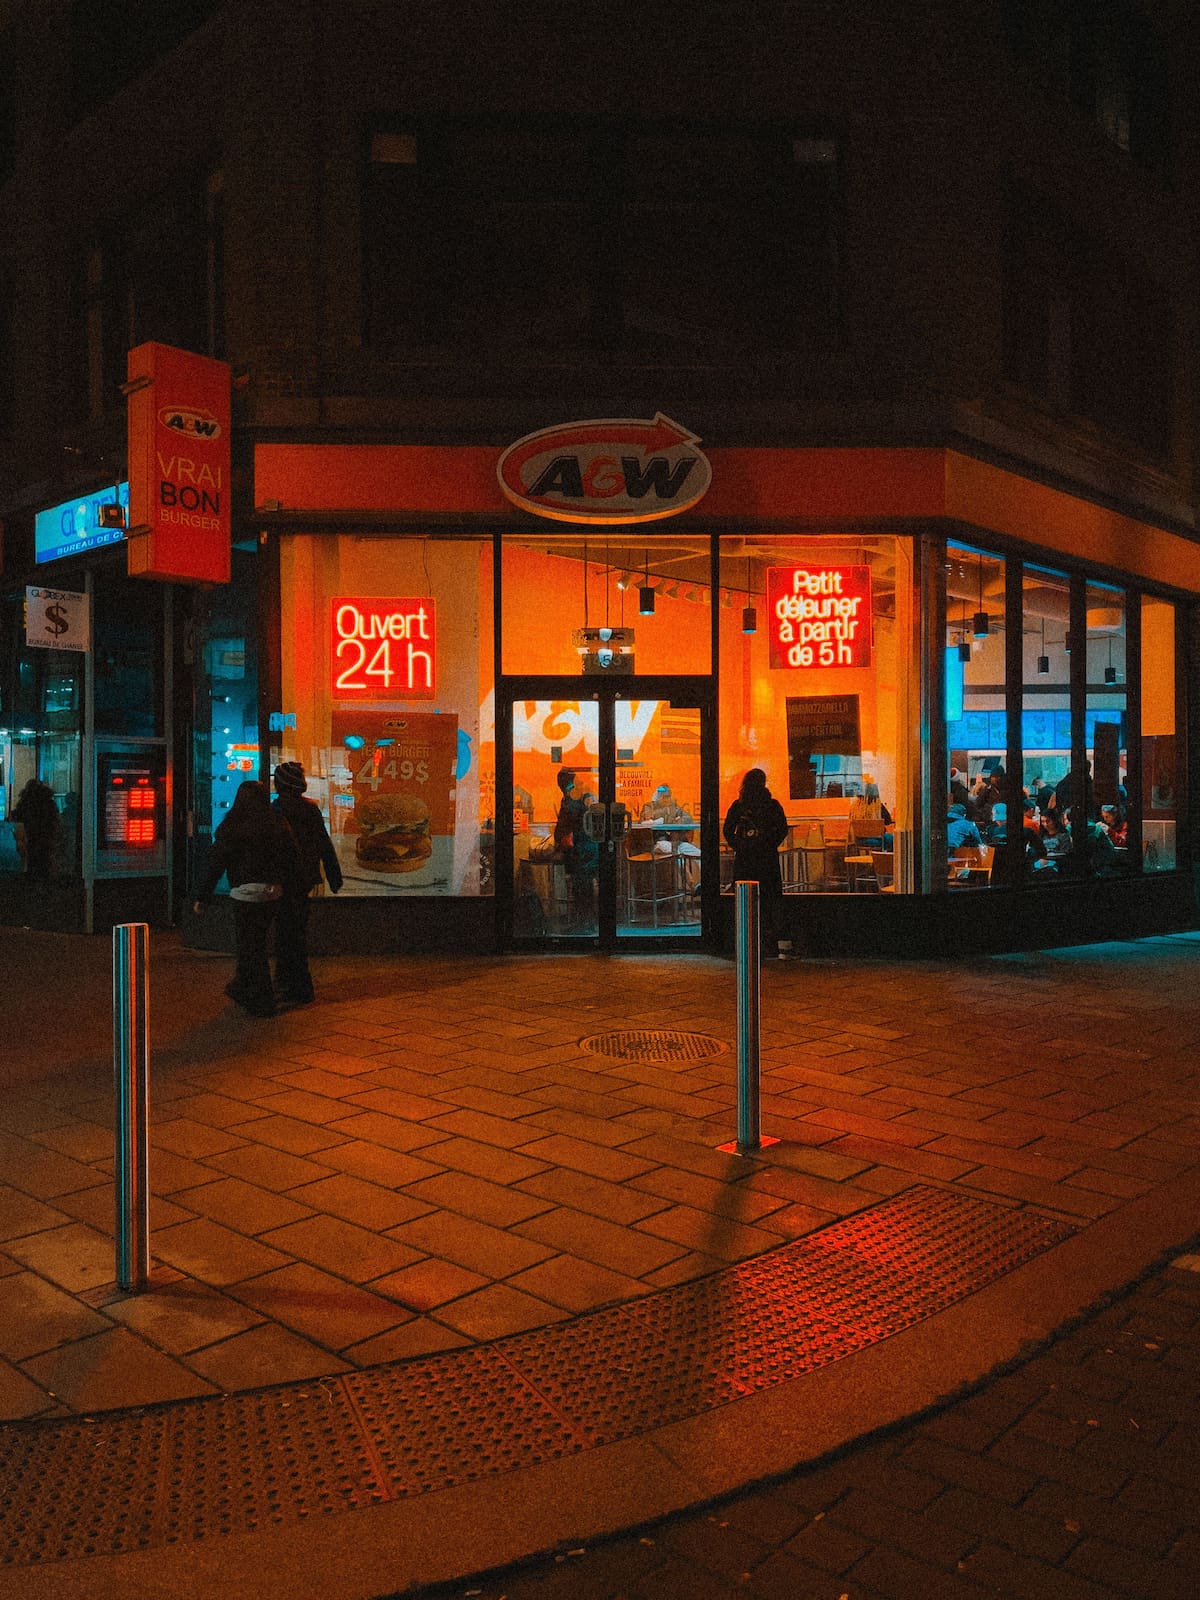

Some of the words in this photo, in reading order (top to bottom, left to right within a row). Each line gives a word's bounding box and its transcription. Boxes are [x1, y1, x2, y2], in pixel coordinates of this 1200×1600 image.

[166, 415, 217, 436] A&W
[156, 450, 222, 489] VRAI
[526, 454, 696, 499] A&W
[159, 480, 220, 517] BON
[160, 508, 220, 531] BURGER
[57, 539, 93, 556] BUREAU
[97, 535, 110, 544] DE
[793, 569, 843, 595] Petit
[776, 594, 862, 622] déjeuner
[335, 604, 431, 641] Ouvert
[800, 614, 859, 645] partir
[336, 638, 394, 690] 24
[407, 640, 432, 690] h
[788, 642, 813, 667] de
[819, 641, 834, 666] 5
[837, 640, 852, 665] h
[390, 746, 430, 758] BURGER
